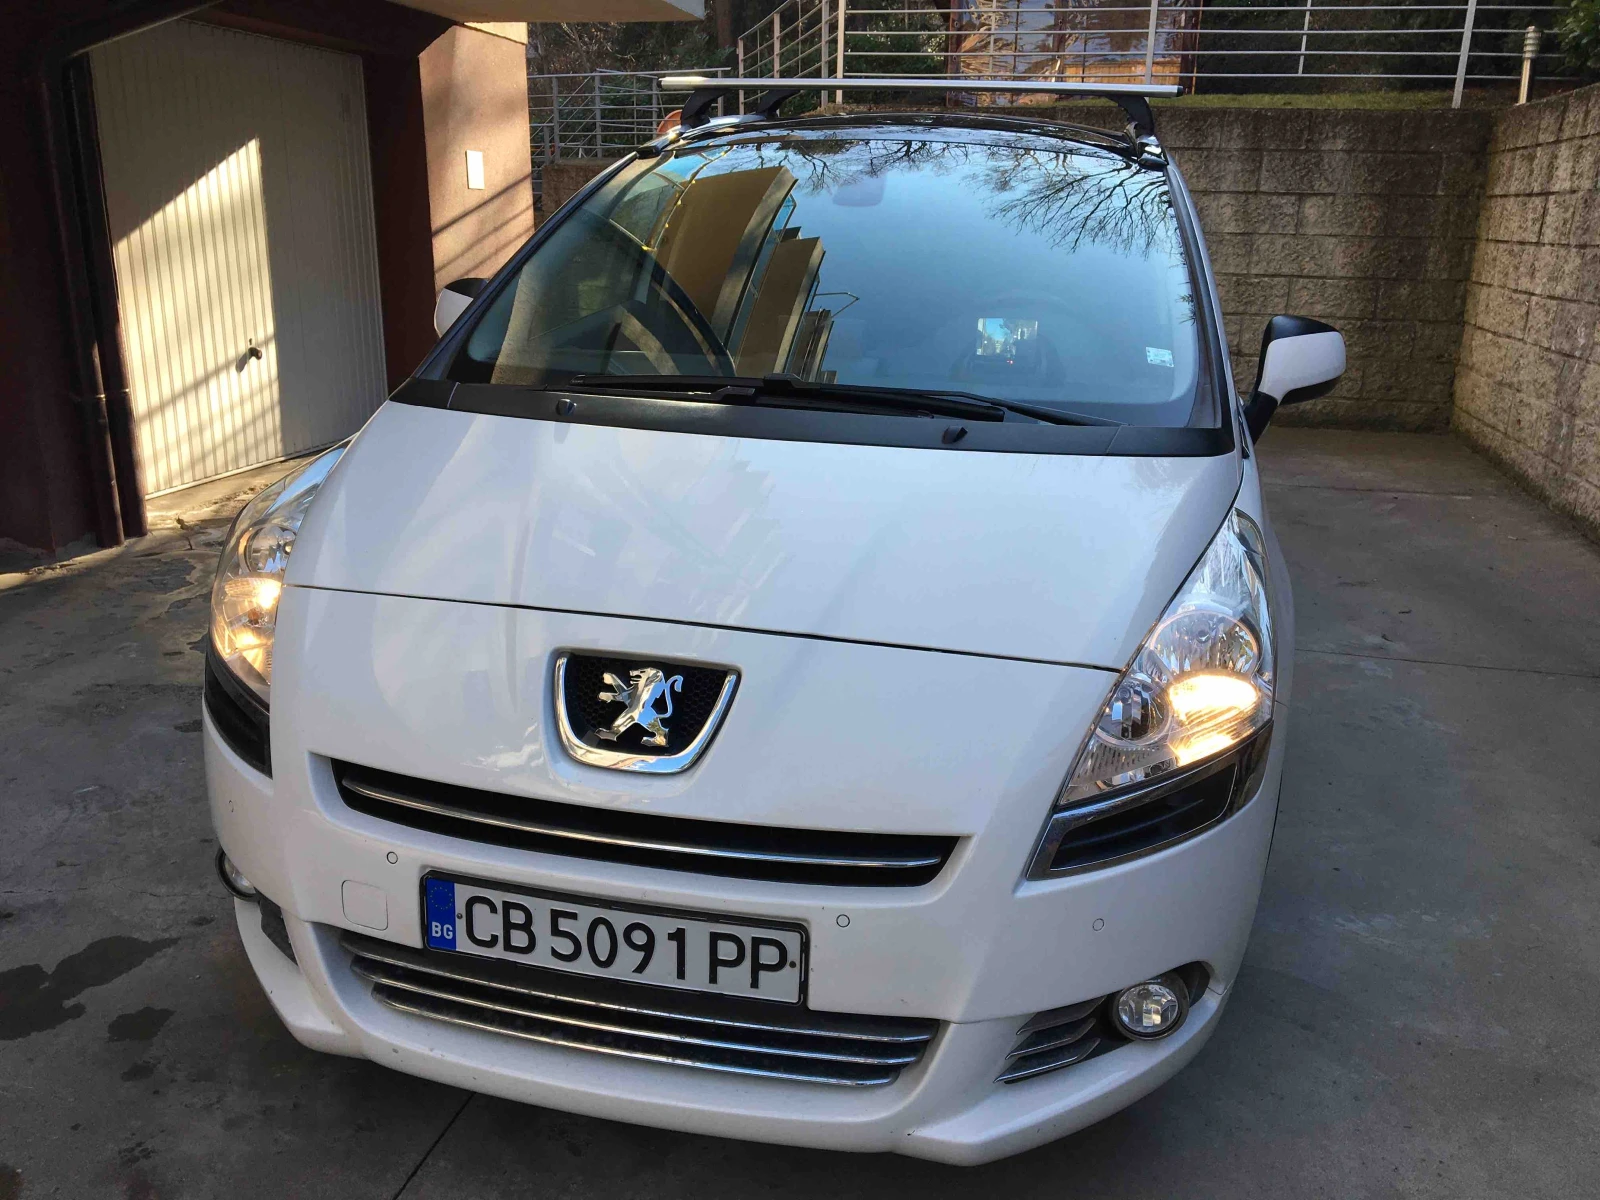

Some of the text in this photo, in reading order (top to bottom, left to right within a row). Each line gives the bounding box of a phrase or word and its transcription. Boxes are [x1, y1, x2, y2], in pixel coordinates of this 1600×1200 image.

[431, 921, 454, 940] BG
[465, 895, 788, 989] CB 5091 PP
